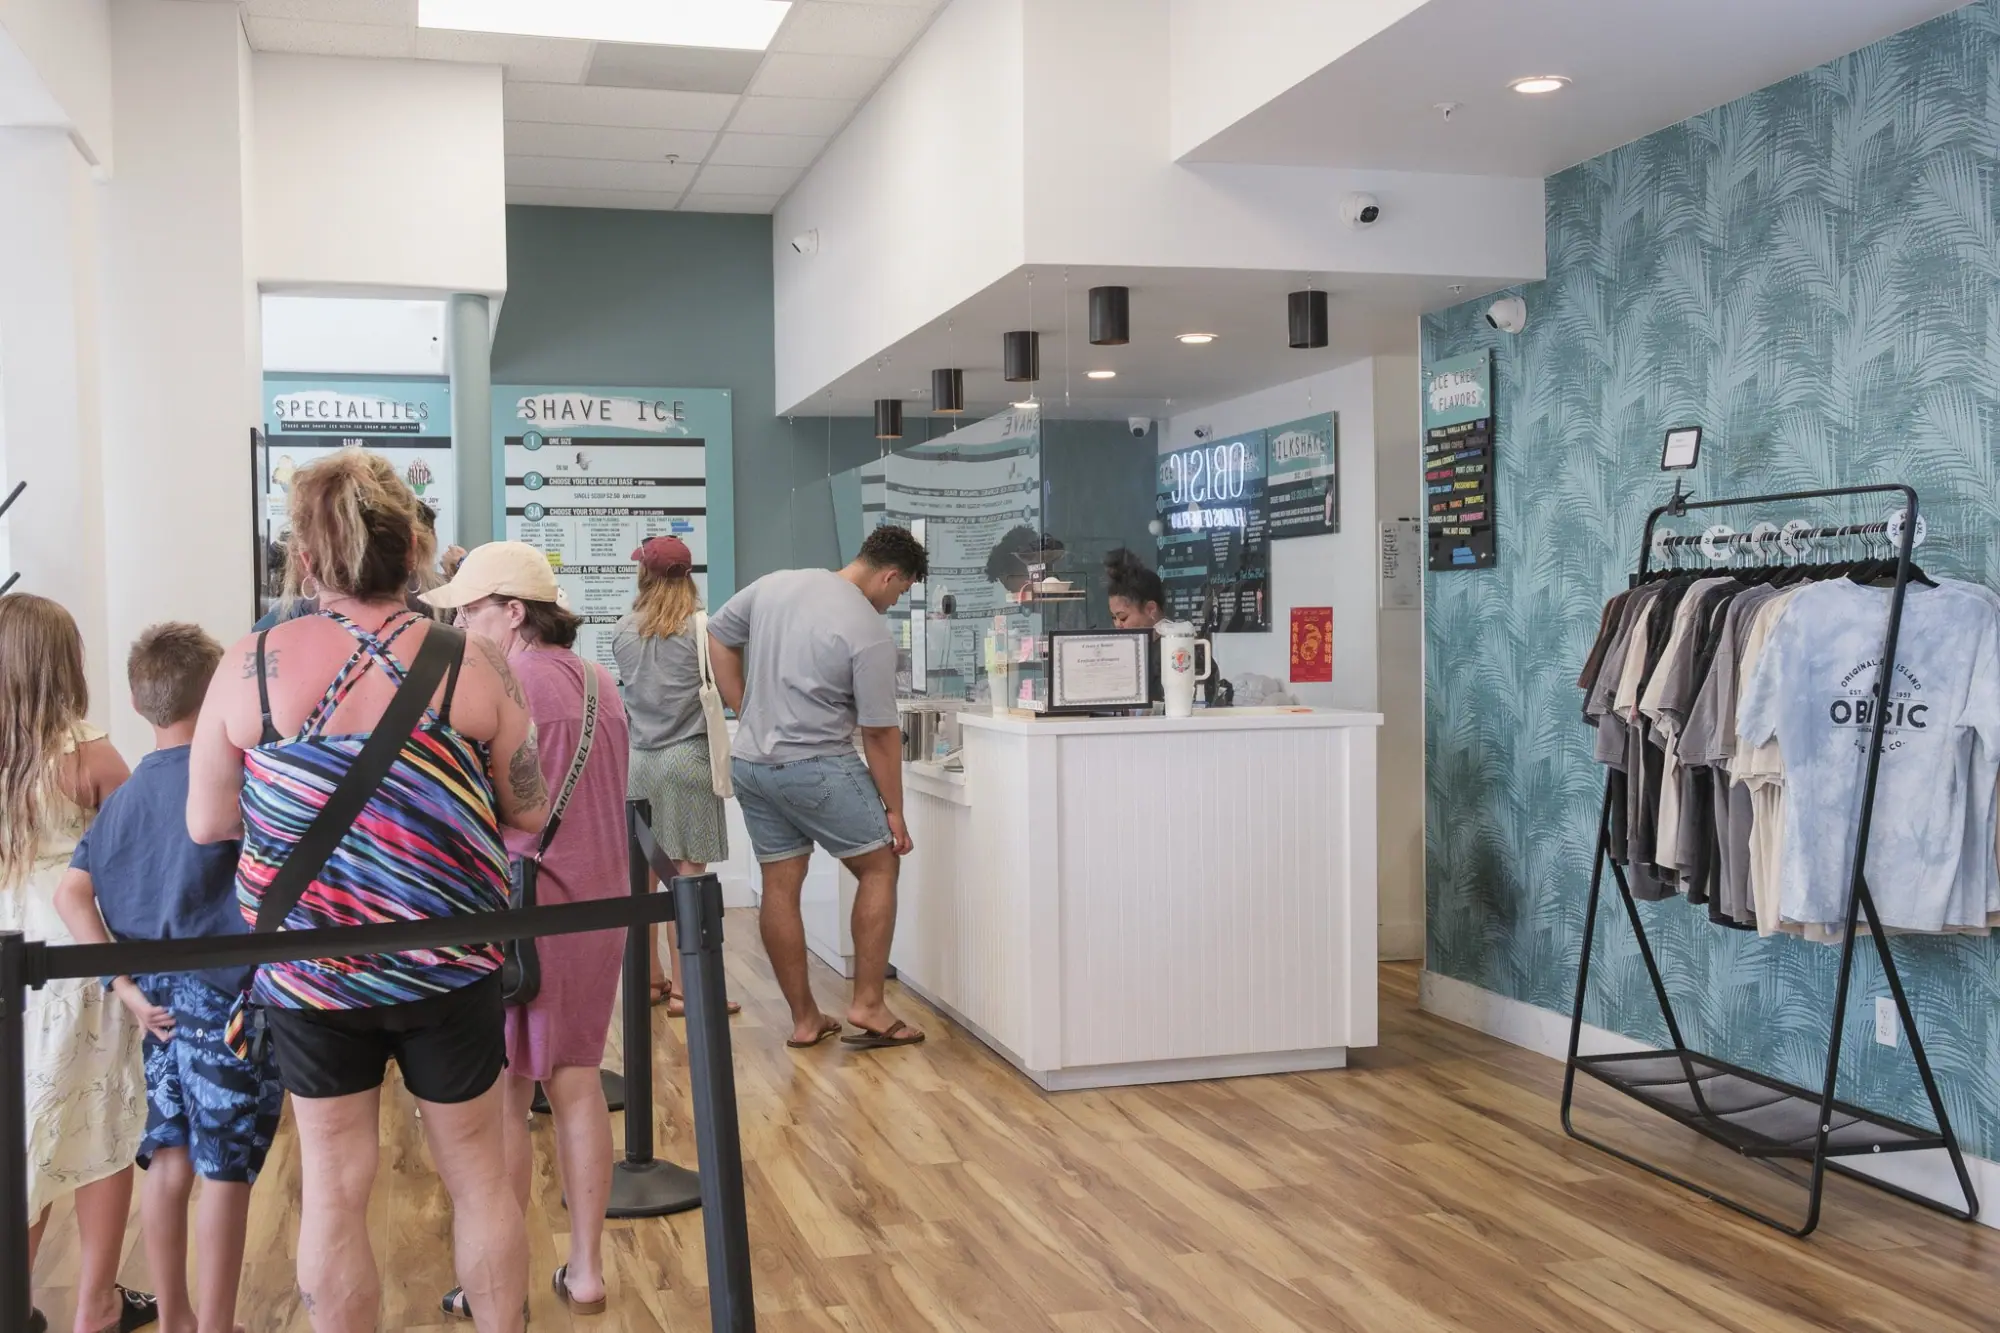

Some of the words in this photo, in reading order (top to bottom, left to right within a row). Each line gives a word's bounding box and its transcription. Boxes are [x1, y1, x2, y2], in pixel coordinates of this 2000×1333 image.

[1434, 373, 1449, 391] ICE
[275, 400, 429, 420] SPECIALTIES
[1439, 390, 1477, 410] FLAVORS
[525, 399, 613, 421] SHAVE
[638, 400, 686, 422] ICE
[530, 476, 537, 486] 2
[598, 478, 618, 486] CREAM
[619, 478, 633, 486] BASE
[527, 506, 541, 517] 3A
[550, 508, 572, 516] CHOOSE
[573, 508, 588, 516] YOUR
[589, 508, 607, 516] SYRUP
[608, 508, 629, 516] FLAVOR
[1841, 659, 1878, 688] ORIGINAL
[1895, 663, 1922, 691] ISLAND
[556, 745, 589, 816] MICHAEL
[584, 694, 597, 739] KORS
